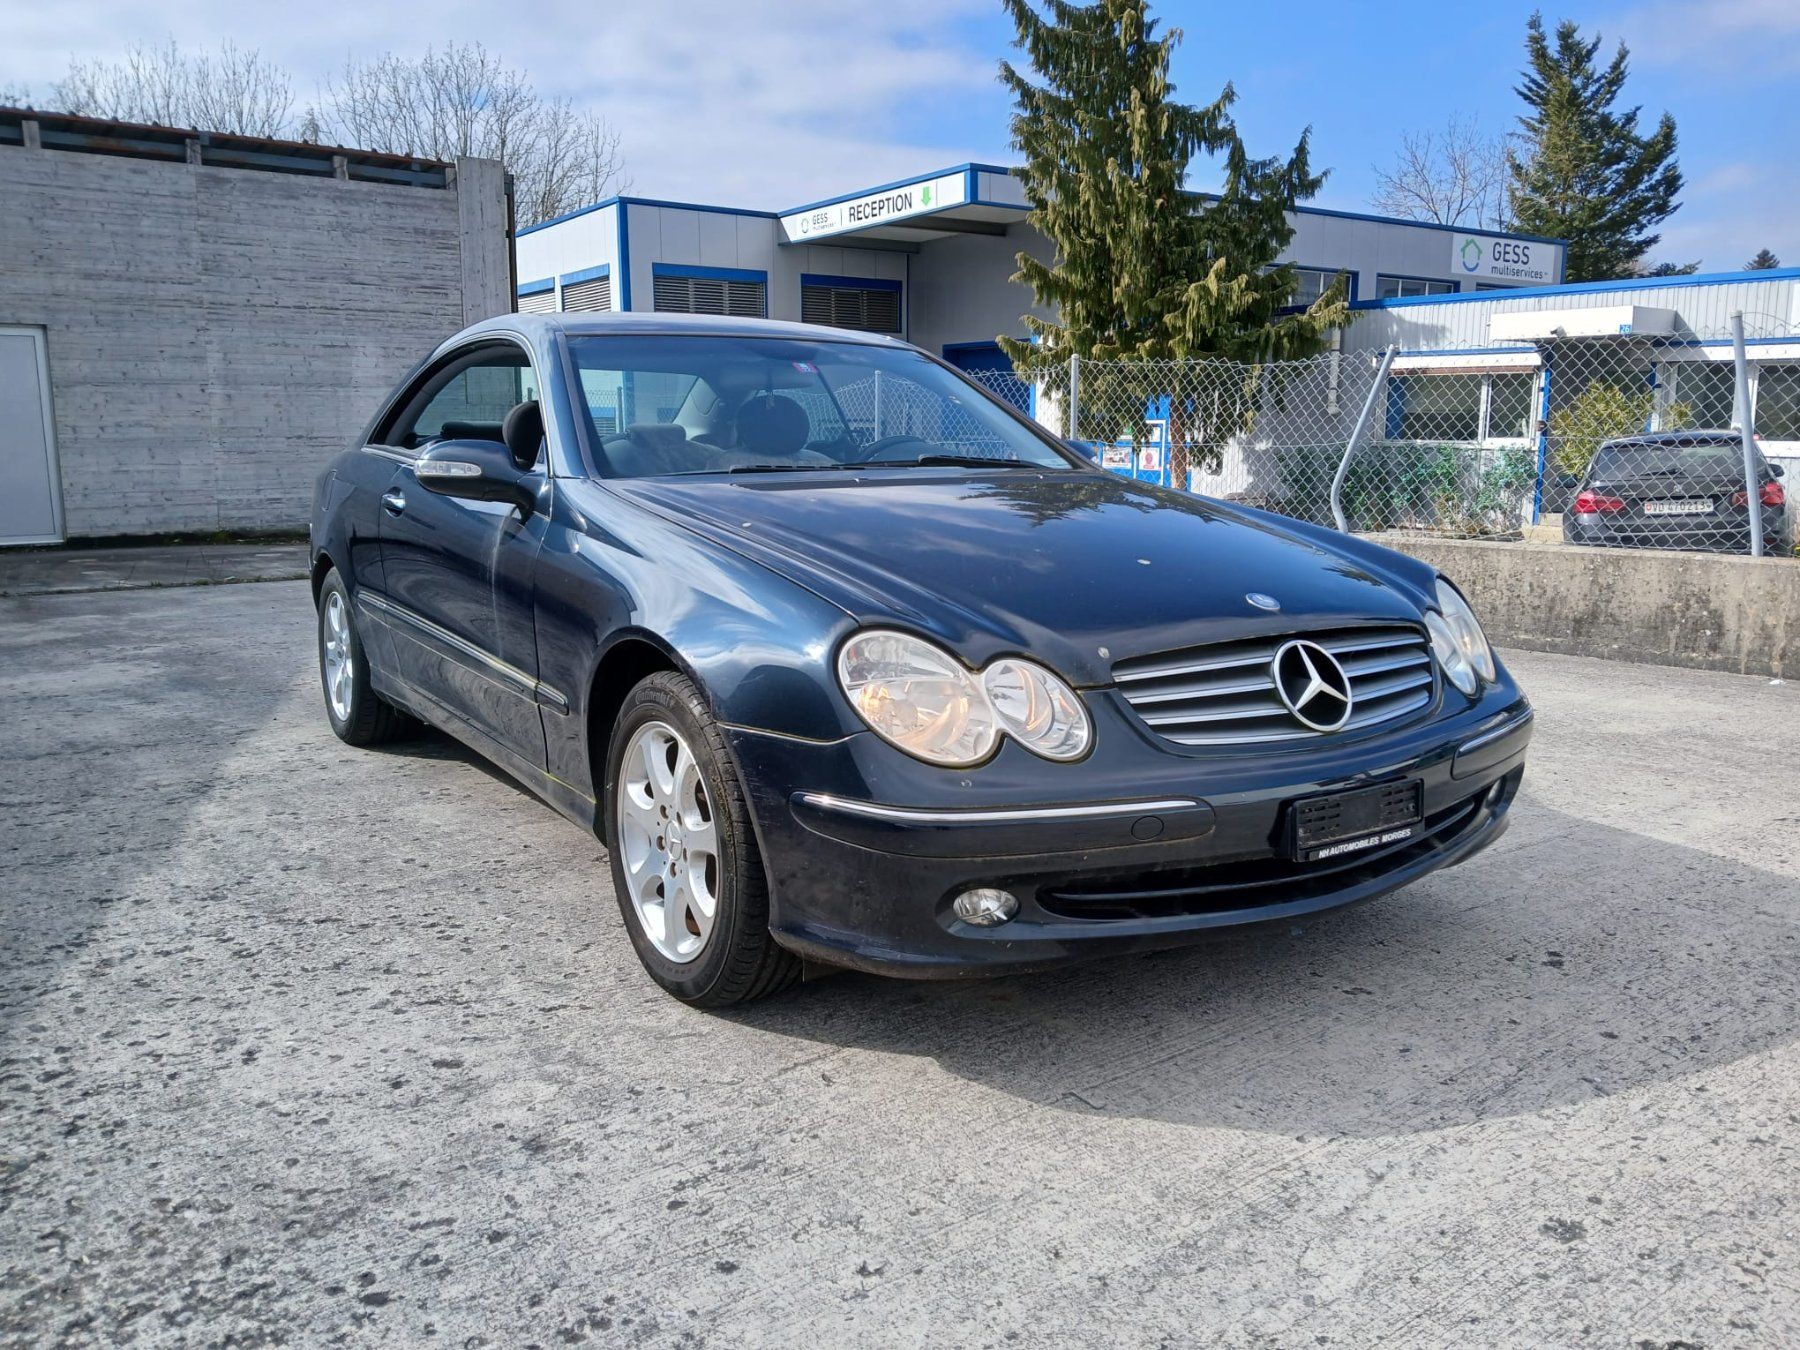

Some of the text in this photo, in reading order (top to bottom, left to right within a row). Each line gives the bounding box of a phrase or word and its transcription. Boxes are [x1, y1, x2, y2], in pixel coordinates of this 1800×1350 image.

[849, 192, 912, 222] RECEPTION
[812, 212, 828, 225] GESS
[1492, 242, 1530, 265] GESS
[1491, 264, 1544, 280] multiservices
[1620, 325, 1631, 333] 26
[1329, 836, 1380, 855] AUTOMOBILES
[1381, 828, 1412, 843] MORGES
